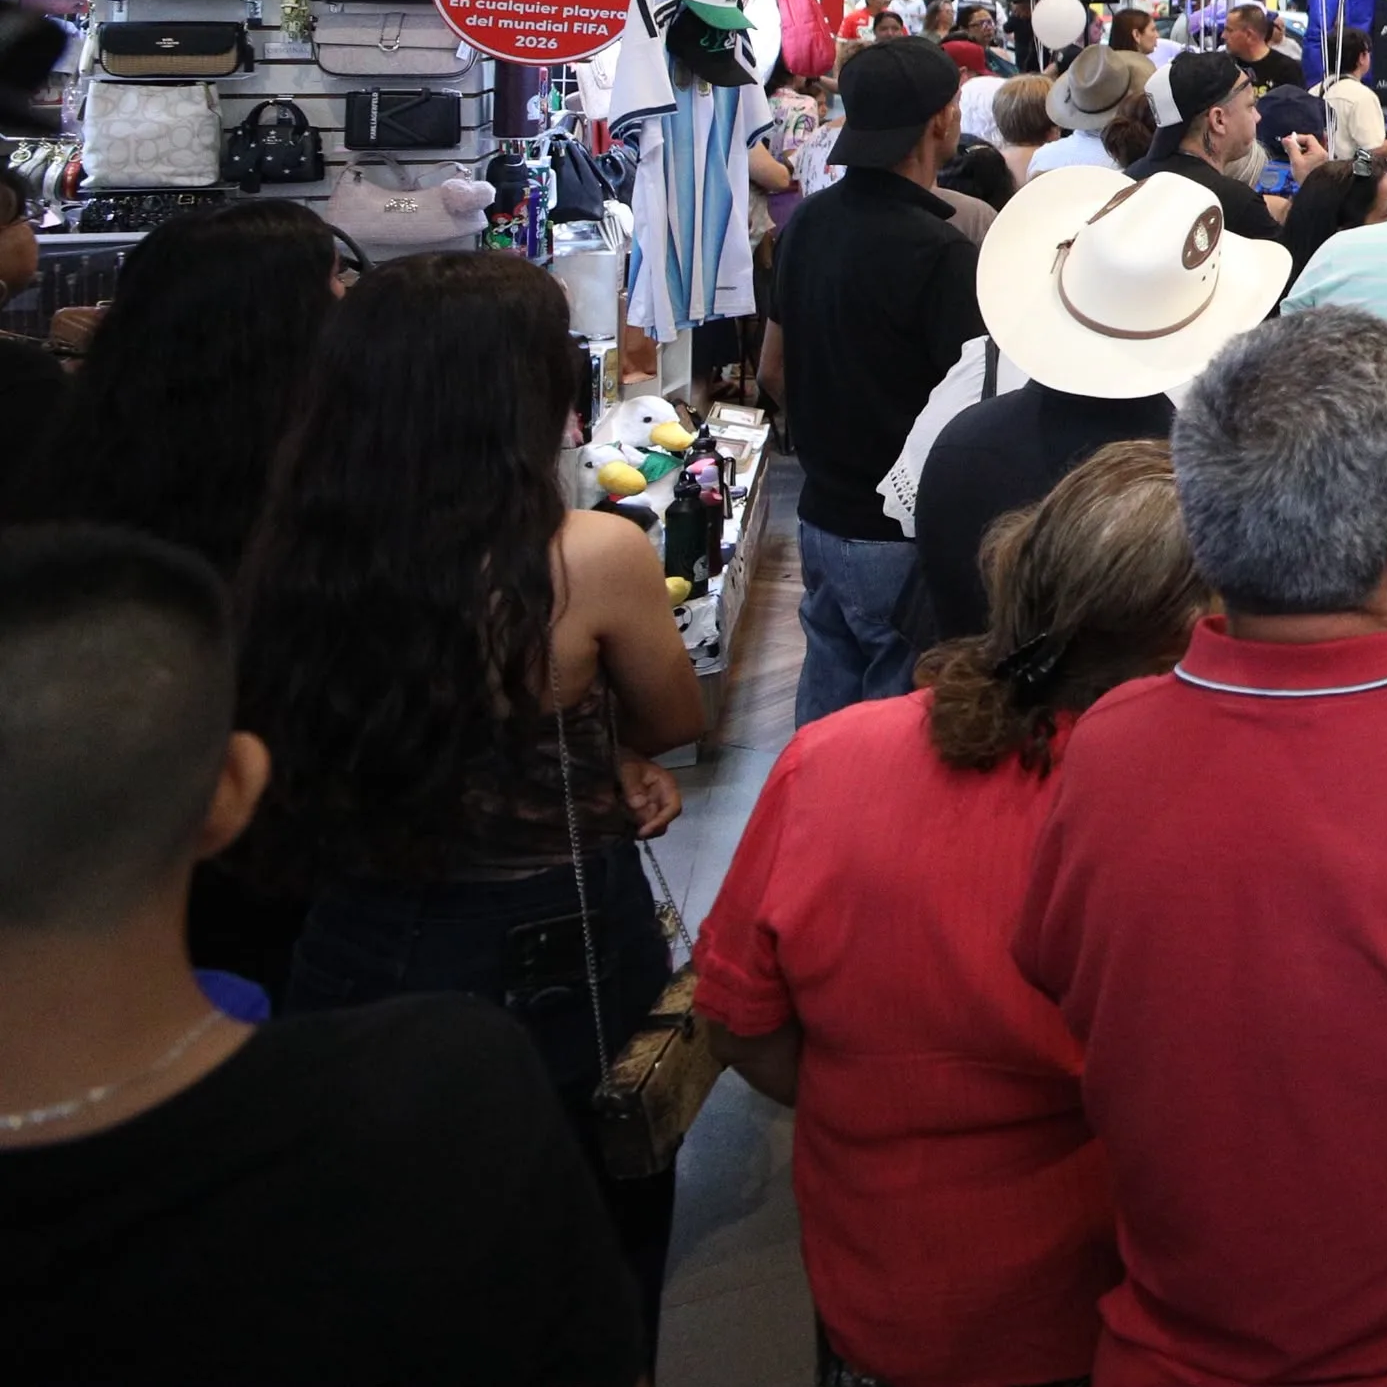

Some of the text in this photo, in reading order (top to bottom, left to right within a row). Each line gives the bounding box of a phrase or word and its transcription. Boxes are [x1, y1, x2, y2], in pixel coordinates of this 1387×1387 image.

[562, 4, 627, 20] playera
[465, 14, 609, 36] del mundial FIFA
[515, 35, 559, 50] 2026
